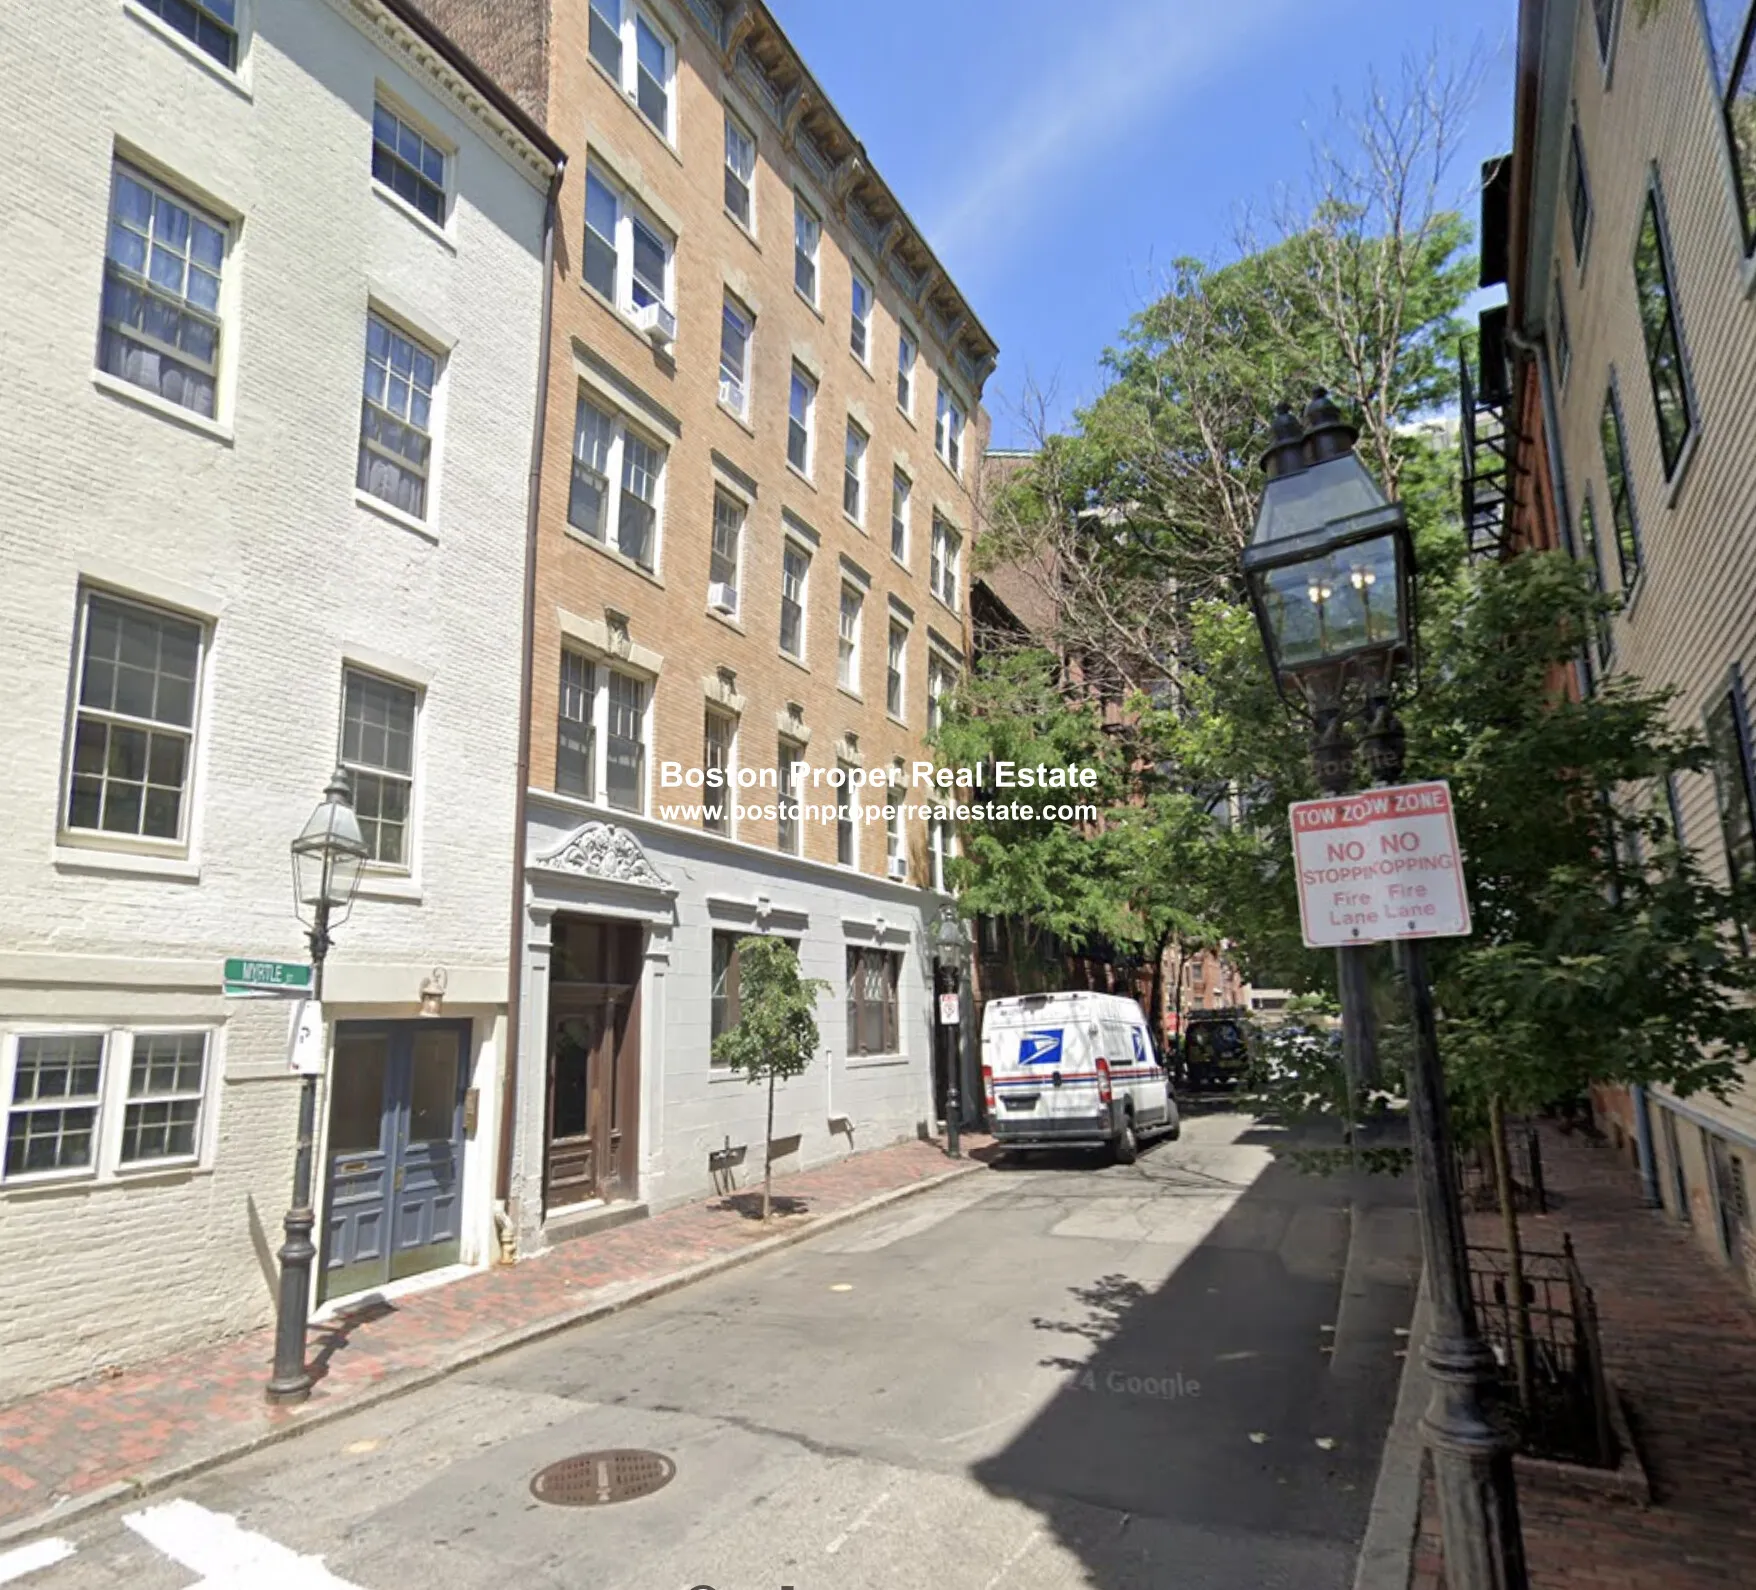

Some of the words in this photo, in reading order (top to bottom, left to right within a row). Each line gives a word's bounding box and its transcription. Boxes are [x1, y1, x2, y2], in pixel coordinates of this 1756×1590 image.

[1296, 807, 1336, 827] TOW
[1395, 790, 1446, 812] ZONE
[1326, 841, 1366, 863] NO
[1380, 831, 1420, 854] NO
[1333, 891, 1371, 906] Fire
[1388, 883, 1427, 898] Fire
[1329, 911, 1378, 926] Lane
[1384, 903, 1436, 919] Lane
